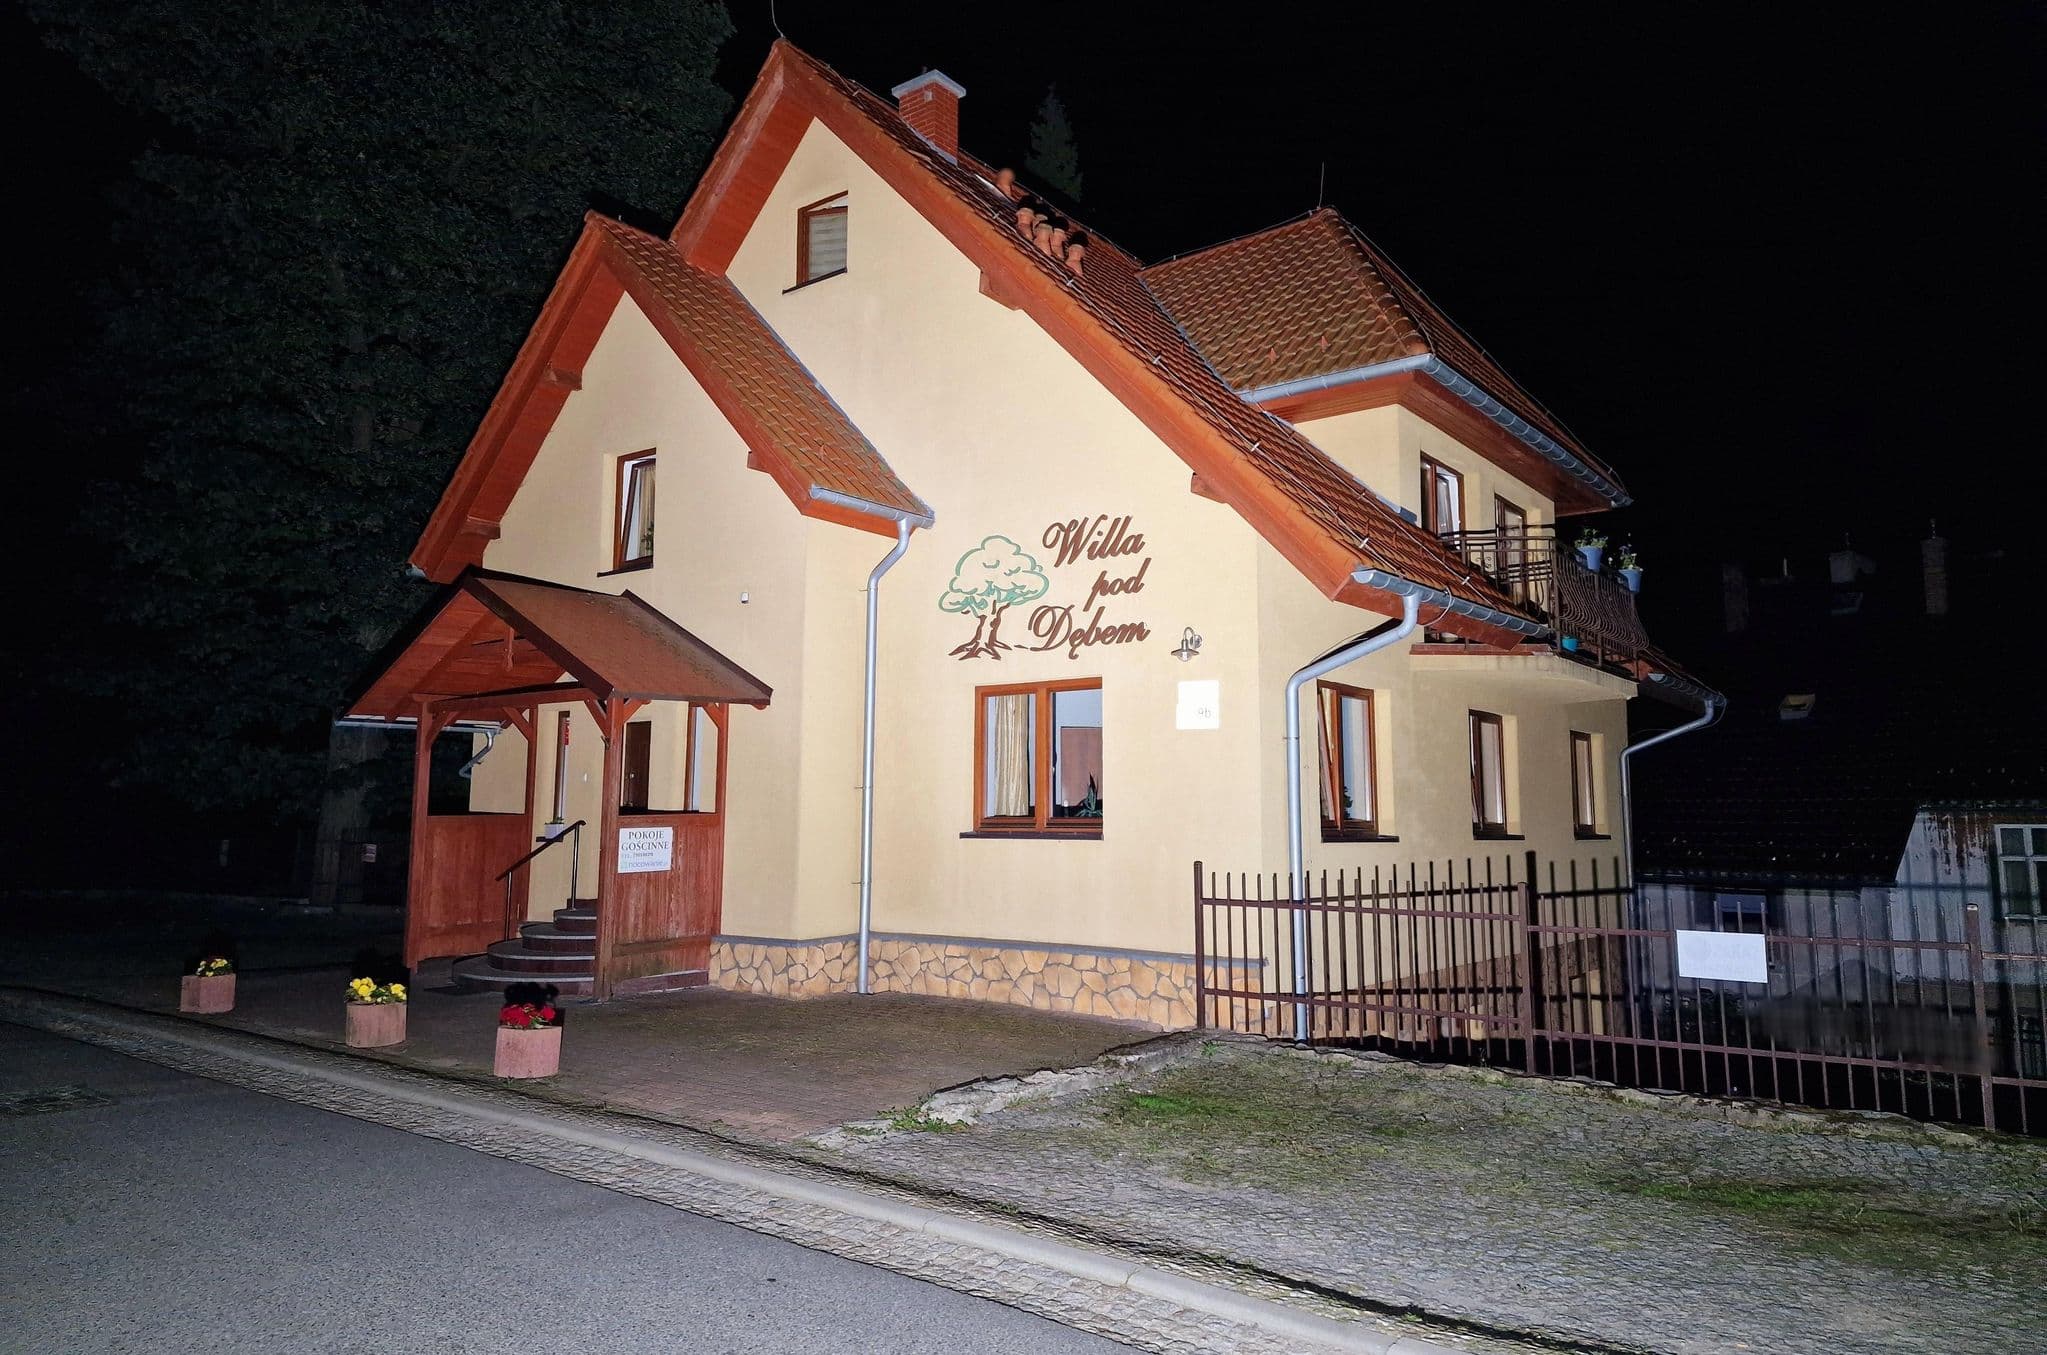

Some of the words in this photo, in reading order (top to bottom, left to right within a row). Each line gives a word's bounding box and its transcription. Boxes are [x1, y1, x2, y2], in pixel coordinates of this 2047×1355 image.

[1042, 514, 1146, 568] Willa
[1082, 557, 1152, 612] pod
[1028, 604, 1151, 660] Dębem
[621, 840, 670, 851] GOŚCINNE
[628, 830, 665, 840] POKOJE
